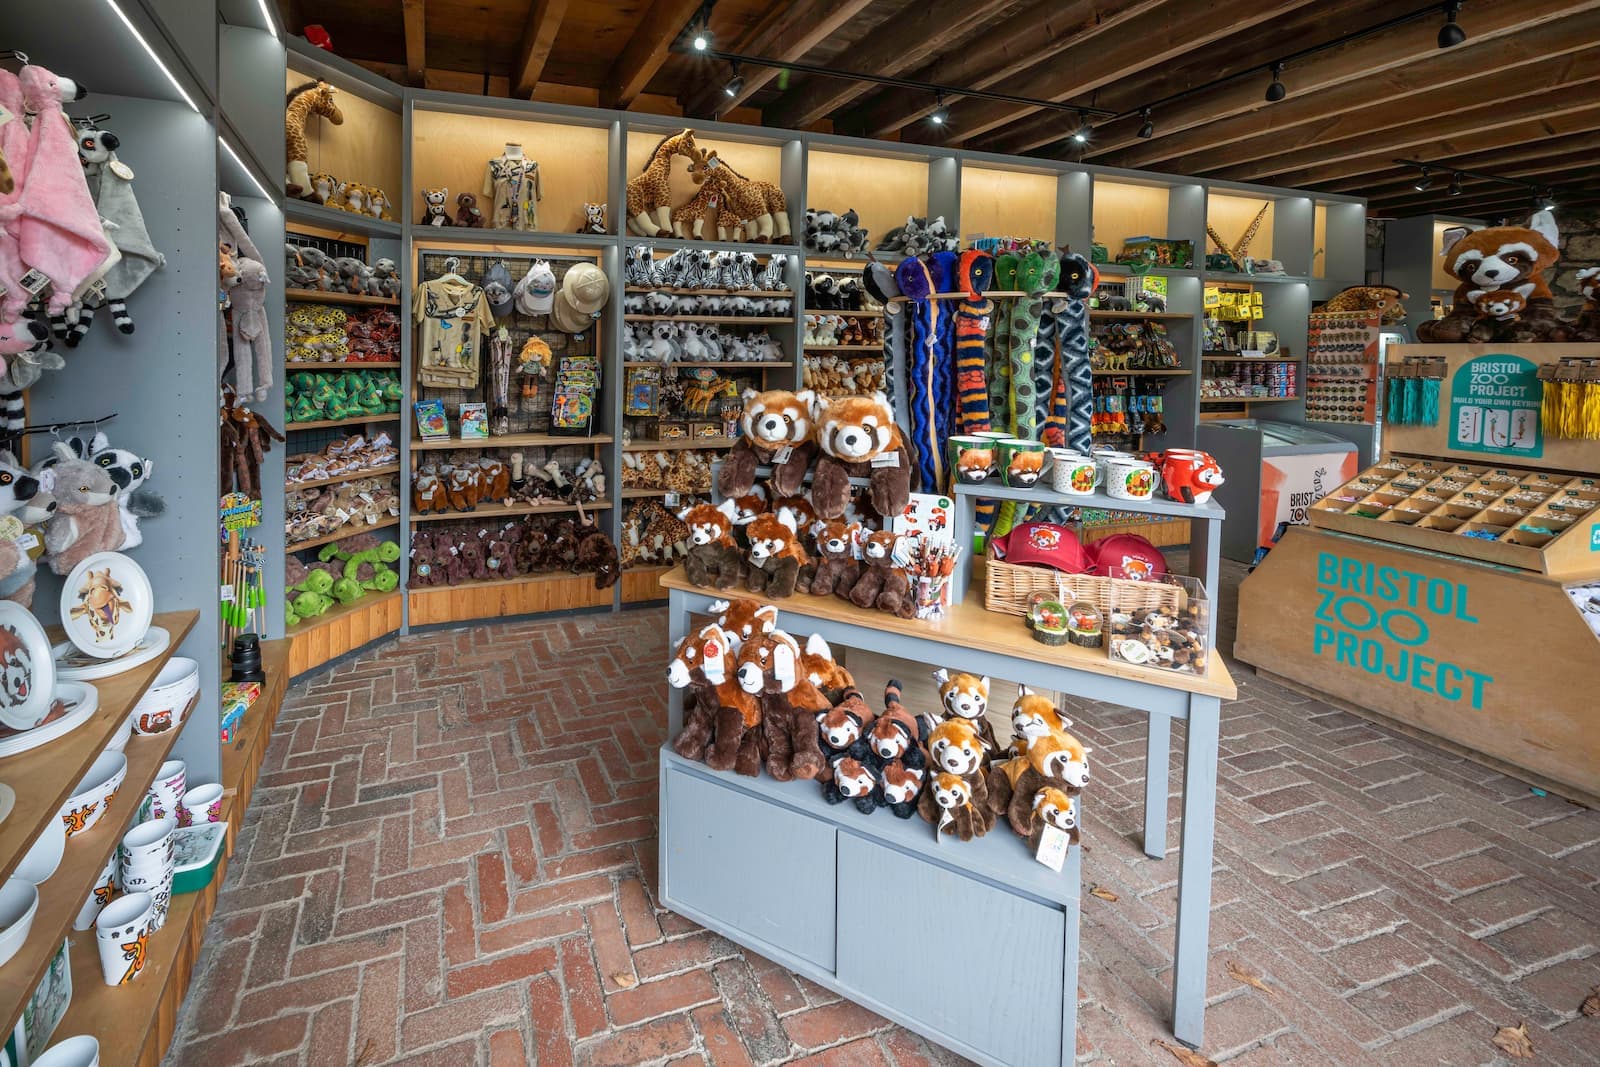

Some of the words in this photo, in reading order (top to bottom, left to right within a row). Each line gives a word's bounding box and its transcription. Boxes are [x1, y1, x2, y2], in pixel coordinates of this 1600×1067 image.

[1470, 373, 1509, 385] ZOO
[1471, 362, 1523, 374] BRISTOL
[1469, 384, 1527, 398] PROJECT
[1317, 551, 1479, 624] BRISTOL
[1315, 588, 1431, 646] ZOO
[1313, 624, 1494, 711] PROJECT
